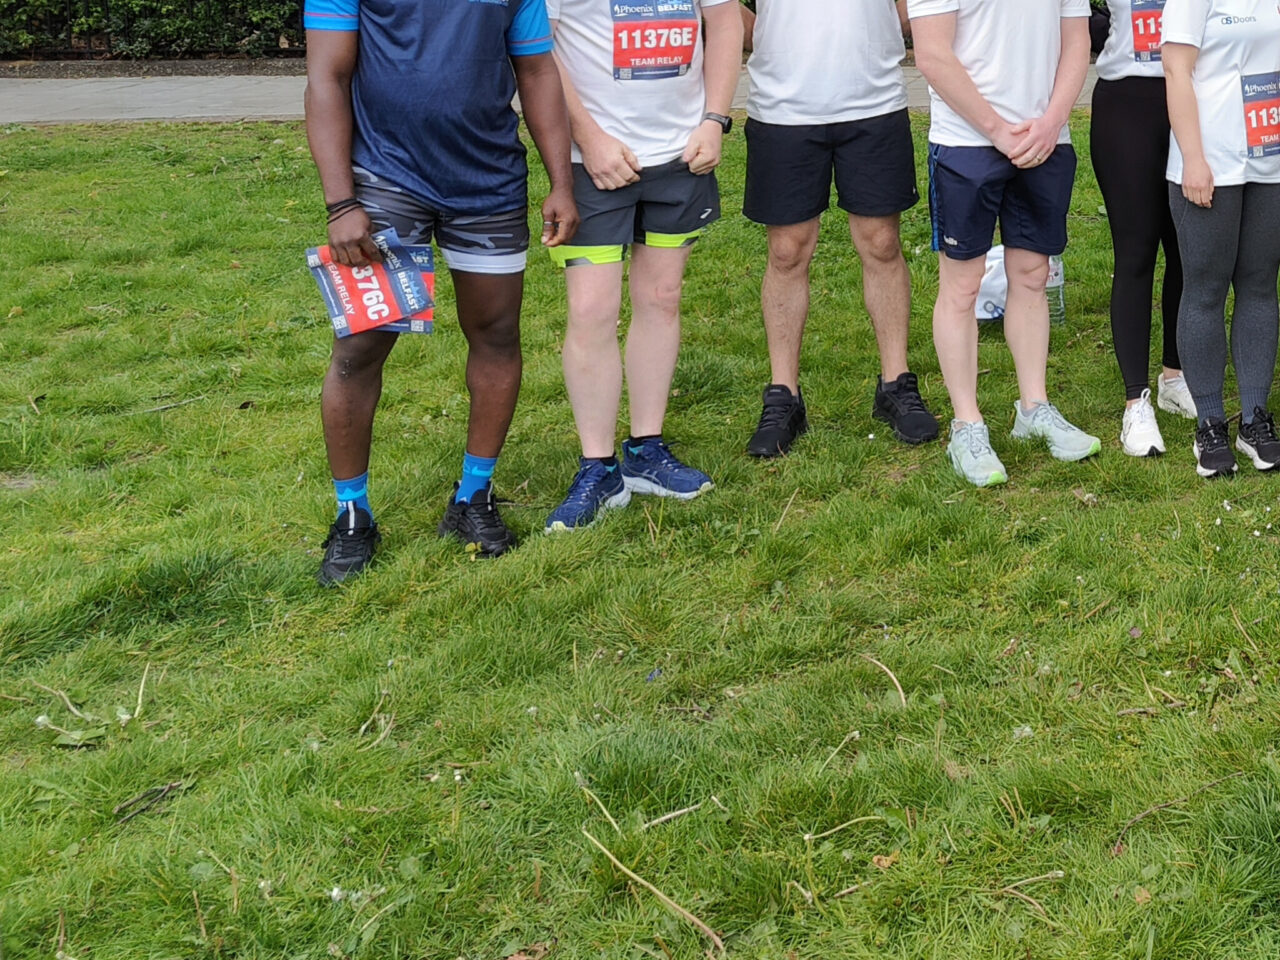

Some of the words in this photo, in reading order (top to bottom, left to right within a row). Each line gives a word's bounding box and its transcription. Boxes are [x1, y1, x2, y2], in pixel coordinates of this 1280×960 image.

[620, 4, 654, 13] Phoenix
[658, 4, 692, 12] BELFAST
[618, 27, 694, 50] 11376E
[630, 58, 655, 66] TEAM
[657, 56, 684, 65] RELAY
[1260, 134, 1278, 143] TEAM
[380, 242, 402, 270] Phoenix
[398, 272, 418, 310] BELFAST
[338, 285, 355, 315] RELAY
[352, 266, 390, 320] 376C
